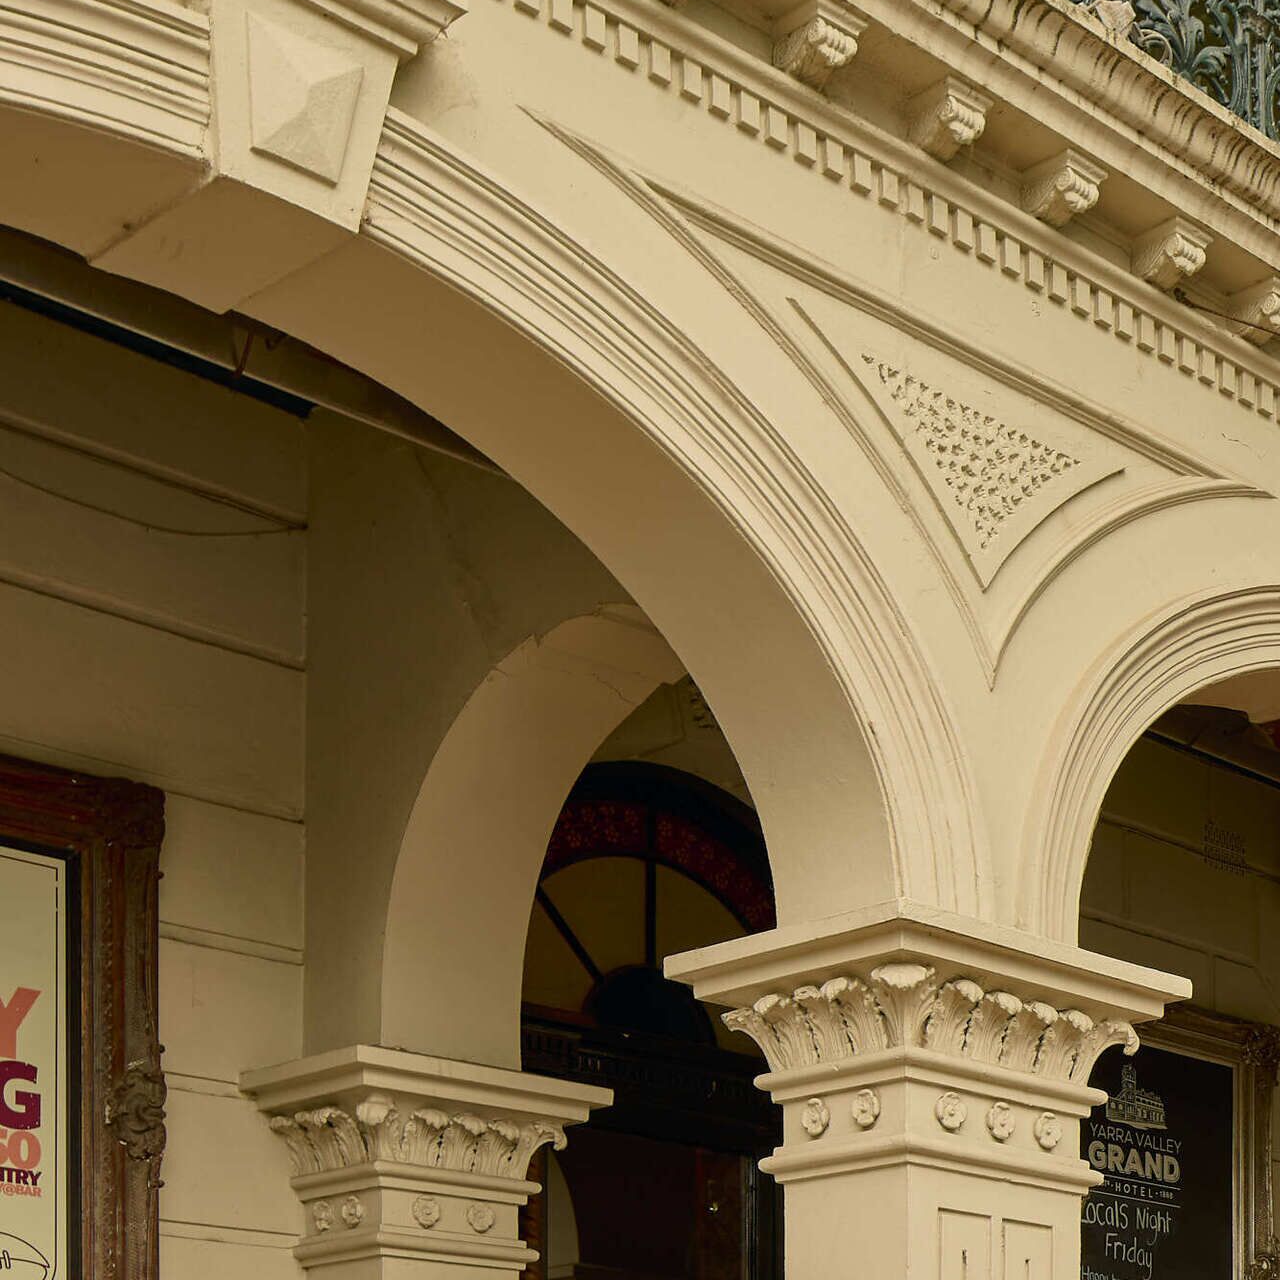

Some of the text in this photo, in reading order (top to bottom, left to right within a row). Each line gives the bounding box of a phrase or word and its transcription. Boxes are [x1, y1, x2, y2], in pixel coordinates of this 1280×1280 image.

[1090, 1122, 1182, 1154] YARRA VALLEY
[1088, 1140, 1180, 1183] GRAND
[1115, 1181, 1153, 1198] HOTEL
[1135, 1206, 1172, 1246] Night
[1105, 1232, 1153, 1280] Friday
